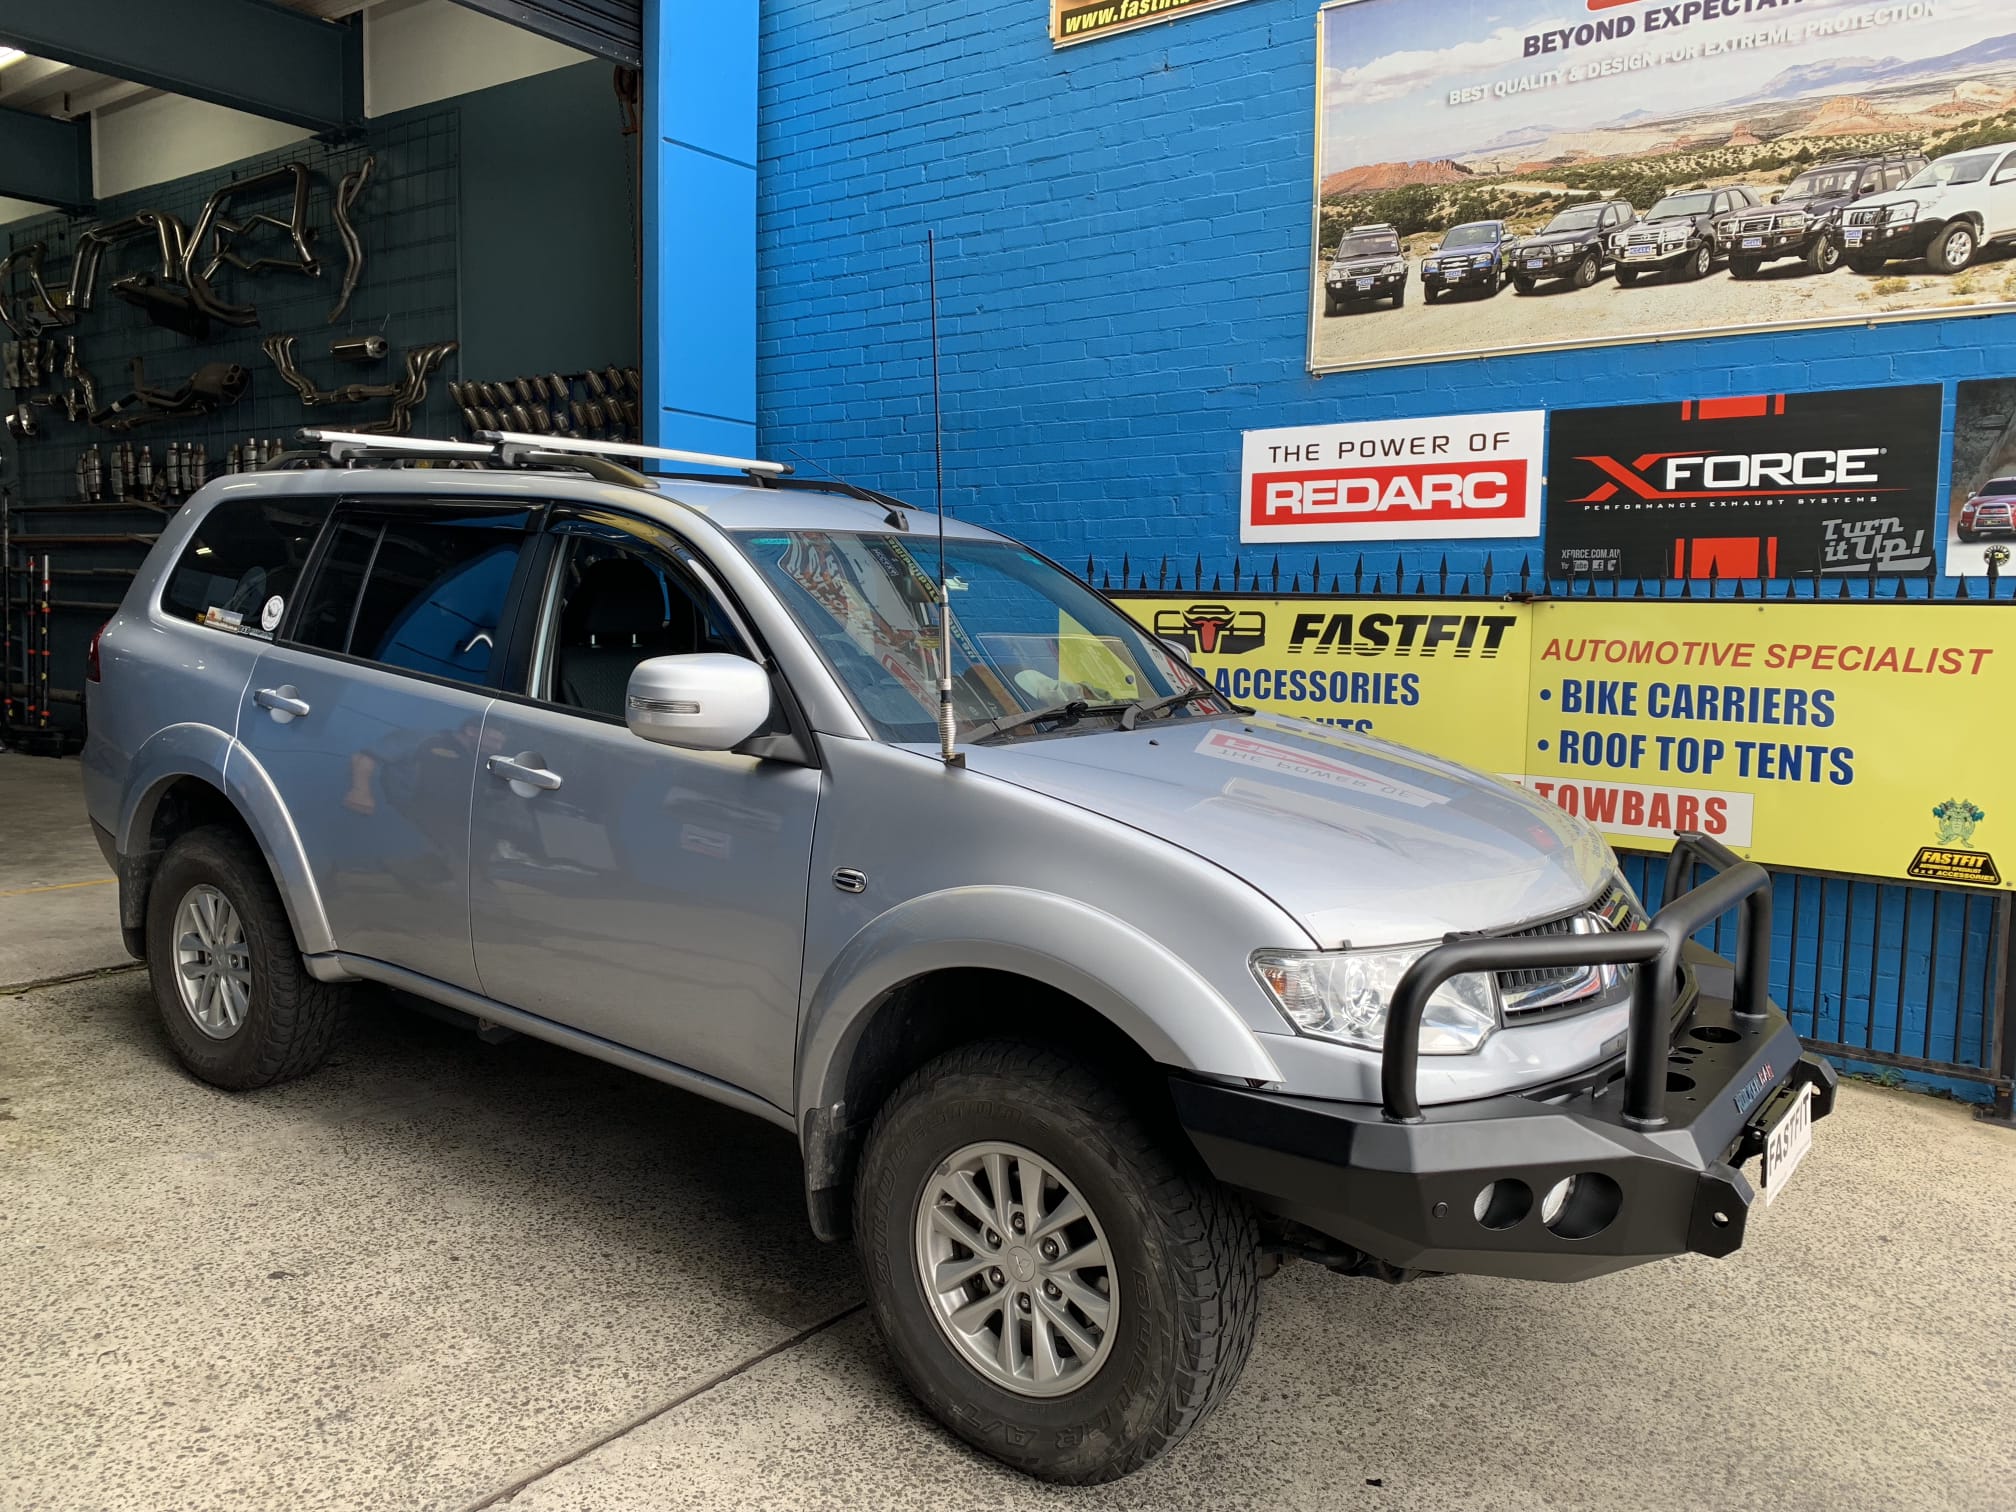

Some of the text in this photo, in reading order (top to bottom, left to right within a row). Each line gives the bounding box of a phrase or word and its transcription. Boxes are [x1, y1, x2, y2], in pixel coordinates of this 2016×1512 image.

[1448, 1, 1935, 105] BEST QUALITY & DESIGN FOR EXTREME PROTECTION
[1523, 16, 1635, 57] BEYOND
[1268, 431, 1511, 463] THE POWER OF
[1265, 472, 1508, 516] REDARC
[1584, 496, 1878, 511] PERFORMANCE EXHAUST SYSTEMS
[1822, 517, 1904, 540] Turn
[1825, 530, 1925, 563] it Up!
[1287, 613, 1517, 659] FASTFIT
[1541, 638, 1993, 676] AUTOMOTIVE SPECIALIST
[1214, 667, 1420, 706] ACCESSORIES
[1561, 679, 1836, 728] BIKE CARRIERS
[1558, 729, 1855, 786] ROOF TOP TENTS
[1535, 782, 1728, 835] TOWBARS
[1921, 851, 1987, 868] FASTFIT
[1936, 870, 1996, 881] ACCESSORIES
[1769, 1093, 1810, 1177] FASTFIT
